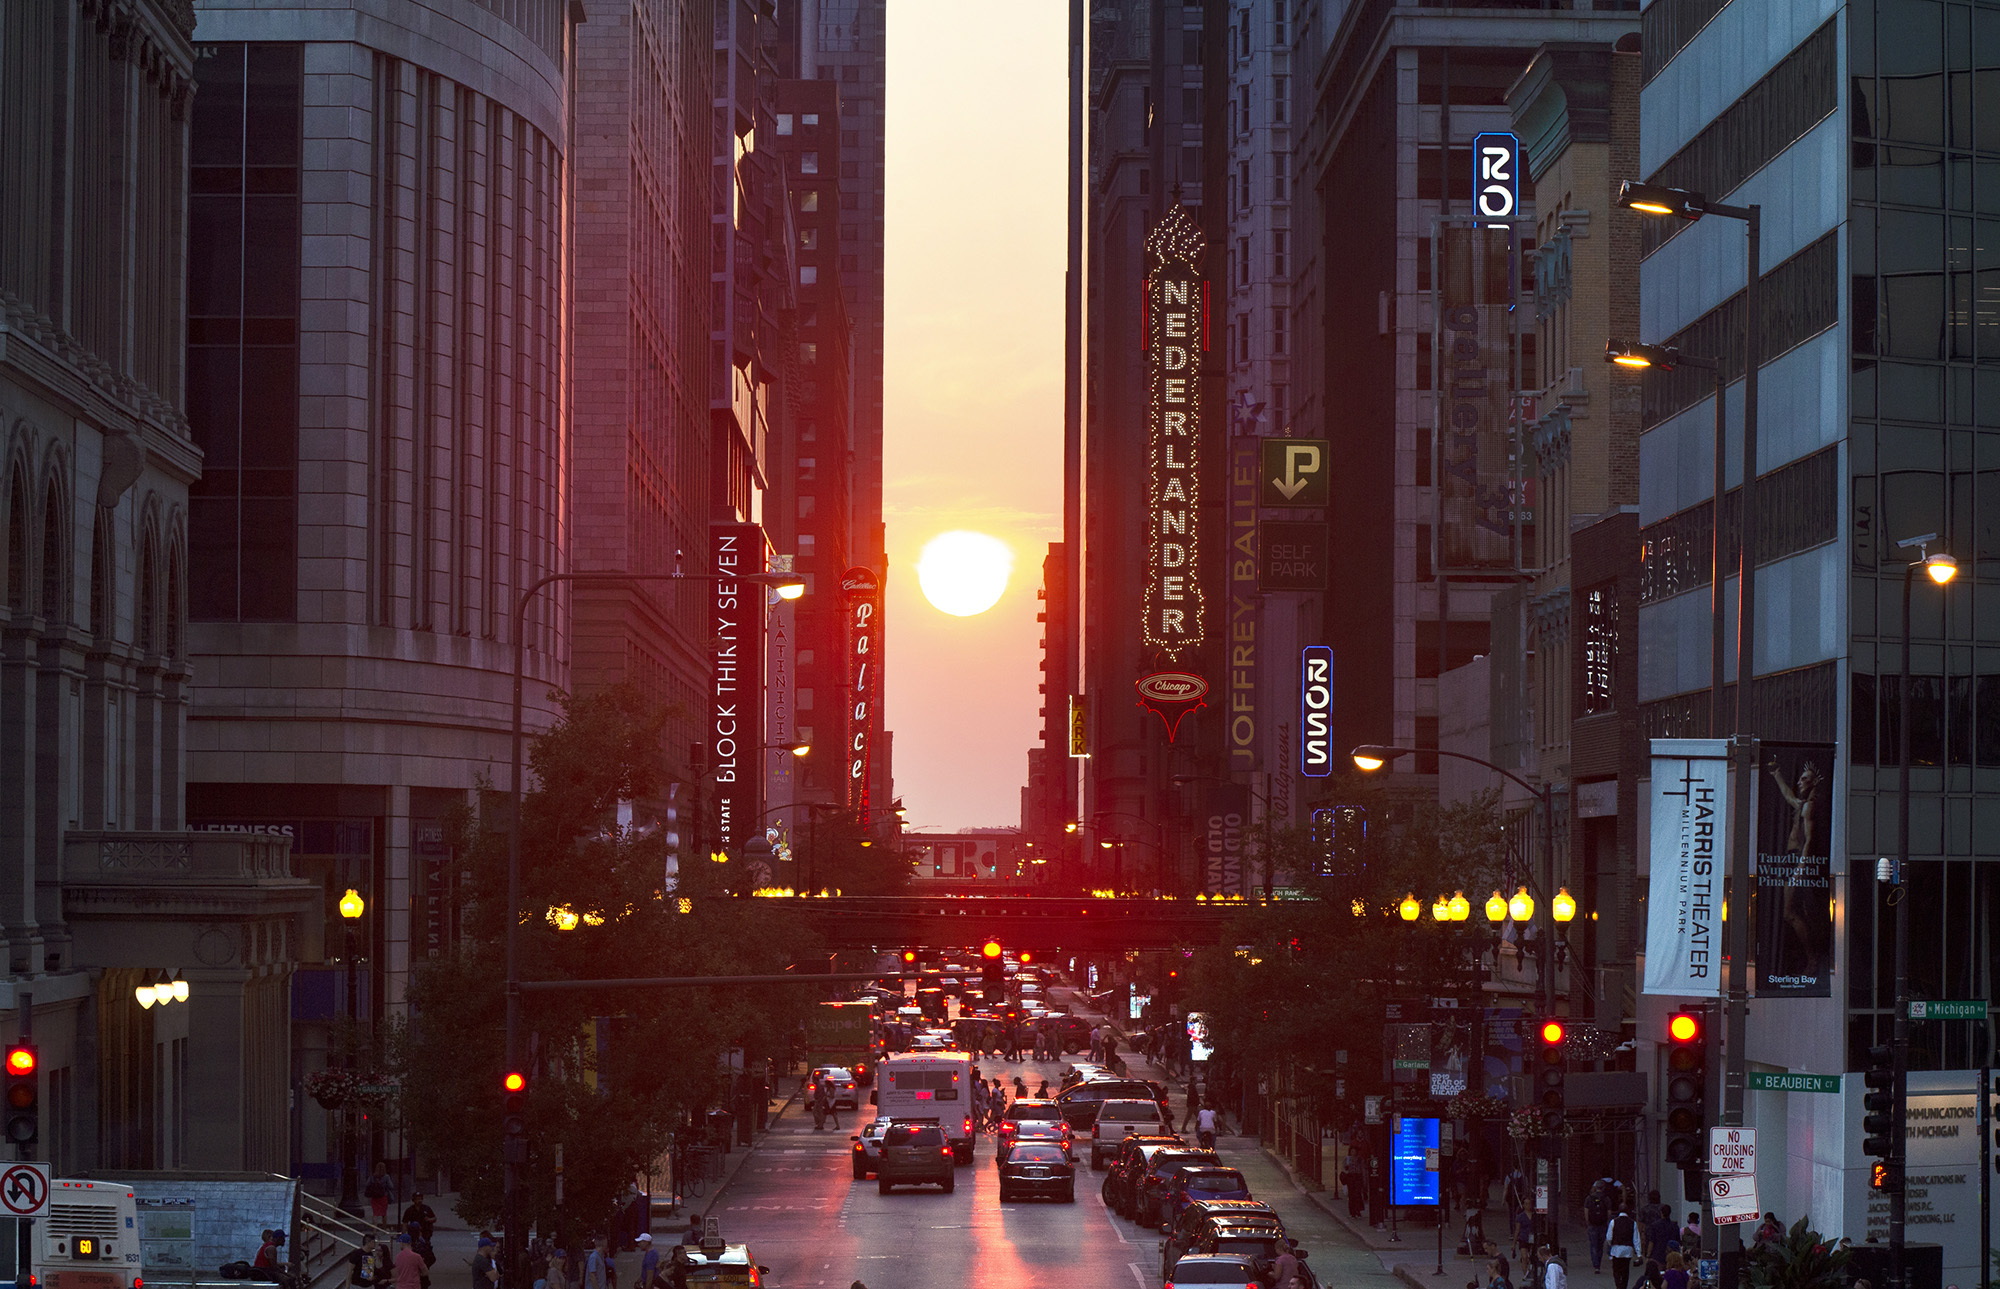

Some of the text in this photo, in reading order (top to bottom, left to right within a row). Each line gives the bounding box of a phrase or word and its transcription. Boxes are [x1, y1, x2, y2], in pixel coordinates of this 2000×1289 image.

[1163, 280, 1188, 634] NEDERLANDER
[1271, 545, 1311, 560] SELF
[718, 536, 738, 609] SEVEN
[1271, 562, 1317, 577] PARK
[1231, 450, 1256, 767] JOFFREY BALLET
[774, 615, 787, 765] LATINICITY
[852, 603, 872, 779] Palace
[1154, 680, 1191, 695] Chicago
[1306, 658, 1329, 765] ROSS
[1074, 696, 1085, 753] PARK
[717, 704, 737, 782] BLOCK
[720, 798, 731, 832] STATE
[1207, 815, 1223, 894] OLD NAV
[1223, 813, 1242, 894] OLD NAV
[1758, 853, 1828, 864] Tanztheater
[1677, 809, 1690, 934] MILLENNIUM PARK
[1758, 864, 1819, 876] Wuppertal
[1690, 788, 1714, 979] HARRIS THEATER
[1758, 876, 1829, 888] Pina Bausch
[1768, 974, 1817, 985] Sterling Bay
[1934, 1003, 1976, 1017] Michigan
[814, 1017, 861, 1032] Peapod
[1402, 1061, 1429, 1069] Garland
[1765, 1076, 1821, 1090] BEAUBIEN
[1825, 1080, 1833, 1088] CT
[1728, 1131, 1740, 1143] NO
[1916, 1125, 1959, 1138] MICHIGAN
[1713, 1144, 1754, 1156] CRUISING
[1722, 1157, 1745, 1169] ZONE
[1717, 1213, 1756, 1224] TOW ZONE
[80, 1240, 92, 1254] 60
[125, 1254, 140, 1262] 1631
